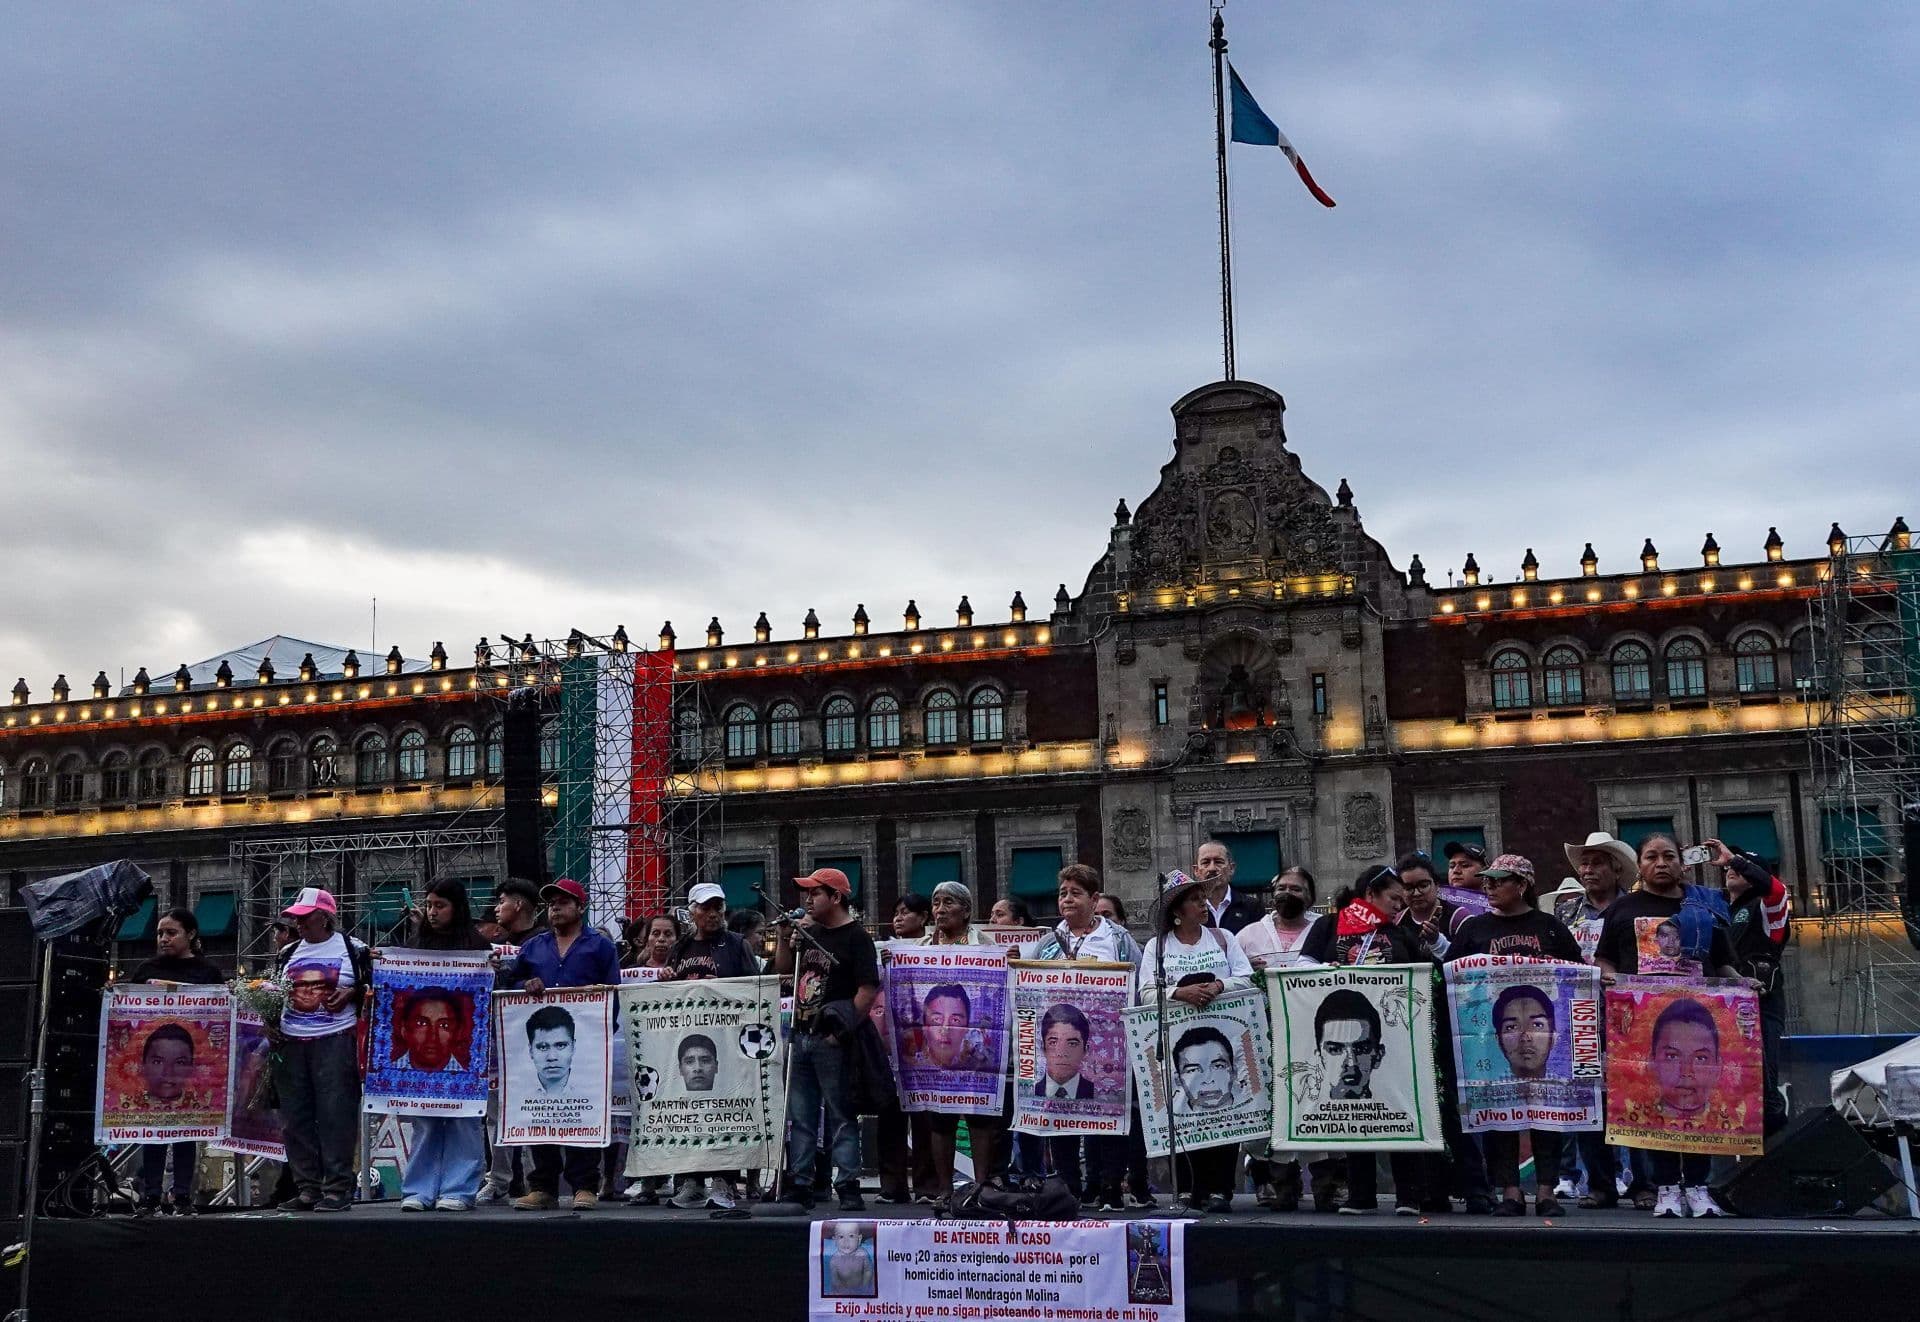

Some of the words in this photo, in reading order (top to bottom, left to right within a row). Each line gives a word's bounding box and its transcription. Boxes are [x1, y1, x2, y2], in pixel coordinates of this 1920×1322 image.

[1574, 930, 1599, 941] Vivo
[1489, 934, 1541, 954] AYOTZINAPA
[379, 958, 410, 968] ¡Porque
[413, 959, 430, 967] vivo
[452, 960, 488, 968] llevaron!
[892, 954, 920, 968] ¡Vivo
[924, 956, 936, 965] se
[941, 955, 951, 966] lo
[955, 955, 1006, 967] llevaron!
[1454, 957, 1487, 972] ¡Vivo
[1491, 955, 1507, 966] se
[1512, 953, 1524, 965] lo
[1017, 971, 1043, 986] ¡Vivo
[1046, 974, 1058, 983] se
[1062, 972, 1072, 984] lo
[1075, 973, 1127, 987] llevaron!
[1286, 977, 1316, 991] ¡Vivo
[1318, 976, 1332, 987] se
[1334, 974, 1346, 985] lo
[1349, 974, 1403, 986] llevaron!
[112, 994, 142, 1007] ¡Vivo
[146, 996, 160, 1006] se
[163, 995, 174, 1006] lo
[178, 995, 229, 1007] llevaron!
[1138, 1012, 1163, 1024] ¡Viv
[1169, 1008, 1181, 1019] se
[1184, 1006, 1194, 1015] lo
[1573, 1000, 1597, 1021] NOS
[647, 1016, 666, 1030] ¡VIVO
[669, 1016, 679, 1027] SE
[681, 1015, 692, 1026] LO
[695, 1013, 739, 1026] LLEVARON!
[1018, 1021, 1035, 1055] FALTAN
[1573, 1026, 1598, 1063] FALTAN
[1019, 1059, 1035, 1079] NOS
[1476, 1058, 1492, 1071] 43
[387, 1100, 409, 1109] ¡Vivo
[411, 1100, 419, 1108] lo
[420, 1101, 463, 1109] queremos!
[652, 1097, 688, 1110] MARTÍN
[691, 1098, 756, 1109] GETSEMANY
[909, 1092, 929, 1104] ¡Vivo
[931, 1092, 937, 1101] lo
[939, 1094, 989, 1105] ueremos!
[1320, 1102, 1349, 1112] CÉSAR
[1351, 1103, 1388, 1111] MANUEL
[648, 1112, 699, 1124] SÁNCHEZ
[704, 1110, 753, 1122] GARCÍA
[1020, 1113, 1038, 1126] ¡Vivo
[1040, 1115, 1049, 1127] lo
[1053, 1118, 1117, 1131] queremos!
[1197, 1113, 1233, 1126] ASCENCIO
[1302, 1111, 1349, 1121] GONZÁLEZ
[1352, 1111, 1407, 1121] HERNÁNDEZ
[1476, 1109, 1507, 1125] ¡Vivo
[1511, 1109, 1523, 1120] lo
[1527, 1109, 1588, 1121] queremos!
[109, 1128, 138, 1140] ¡Vivo
[142, 1127, 153, 1138] lo
[157, 1127, 218, 1139] queremos!
[507, 1126, 525, 1138] ¡Con
[527, 1125, 547, 1137] VIDA
[549, 1125, 558, 1136] lo
[559, 1125, 601, 1138] queremos!
[669, 1124, 690, 1133] VIDA
[694, 1125, 703, 1133] lo
[707, 1124, 760, 1134] queremos!
[1296, 1123, 1319, 1136] ¡Con
[1320, 1122, 1344, 1134] VIDA
[1347, 1122, 1357, 1133] lo
[1359, 1122, 1413, 1136] queremos!
[1184, 1133, 1208, 1145] VIDA
[1210, 1131, 1219, 1140] lo
[238, 1140, 246, 1149] lo
[246, 1142, 285, 1155] queremos!
[934, 1231, 947, 1244] DE
[951, 1232, 1000, 1245] ATENDER
[1022, 1232, 1050, 1245] CASO
[888, 1249, 911, 1262] llevo
[933, 1250, 957, 1263] años
[961, 1251, 1010, 1267] exigiendo
[1013, 1252, 1063, 1265] JUSTICIA
[1069, 1254, 1086, 1267] por
[1090, 1253, 1099, 1265] el
[904, 1268, 954, 1281] homicidio
[957, 1269, 1025, 1282] internacional
[1029, 1271, 1041, 1283] de
[1044, 1271, 1057, 1283] mi
[1060, 1271, 1083, 1284] niño
[928, 1286, 962, 1299] Ismael
[965, 1287, 1021, 1304] Mondragón
[1025, 1288, 1060, 1302] Molina
[835, 1302, 860, 1317] Exijo
[864, 1302, 904, 1315] Justicia
[906, 1305, 912, 1317] y
[915, 1305, 934, 1319] que
[937, 1305, 949, 1316] no
[952, 1304, 980, 1319] sigan
[983, 1305, 1041, 1319] pisoteando
[1044, 1306, 1053, 1318] la
[1056, 1306, 1102, 1319] memoria
[1105, 1307, 1118, 1320] de
[1122, 1308, 1136, 1320] mi
[1139, 1308, 1159, 1322] hijo
